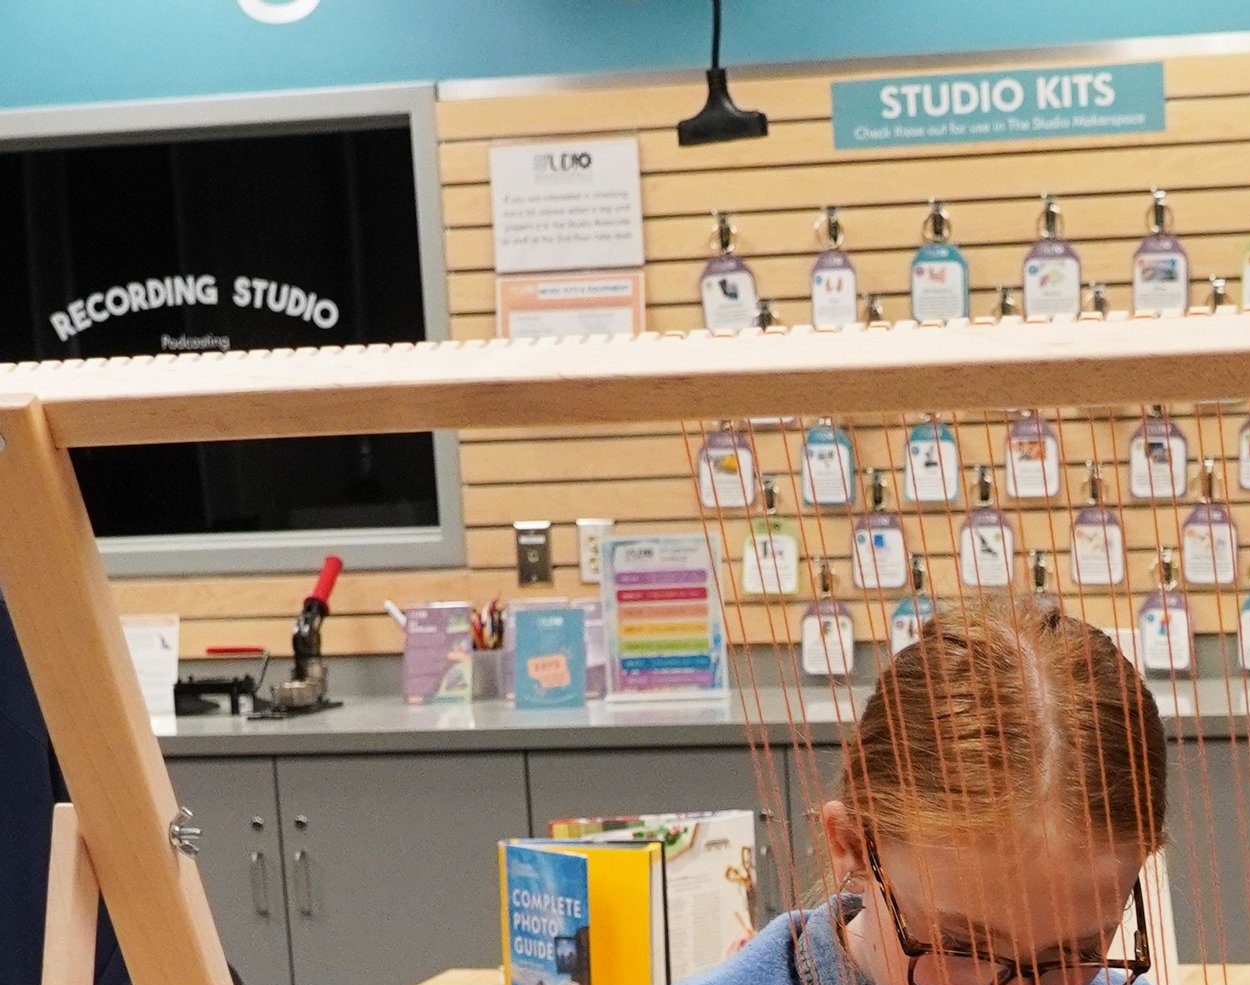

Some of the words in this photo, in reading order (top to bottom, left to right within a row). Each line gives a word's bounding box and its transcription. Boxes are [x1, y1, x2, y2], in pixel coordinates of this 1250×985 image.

[880, 77, 1024, 119] STUDIO
[1036, 72, 1116, 110] KITS
[854, 125, 891, 140] Check
[893, 123, 925, 137] these
[948, 120, 967, 135] for
[968, 123, 992, 135] use
[1031, 114, 1071, 130] Studio
[50, 274, 218, 342] RECORDING
[233, 275, 339, 329] STUDIO
[161, 332, 230, 352] Podcasting
[512, 888, 582, 919] COMPLETE
[513, 911, 559, 937] PHOTO
[513, 935, 556, 961] GUIDE
